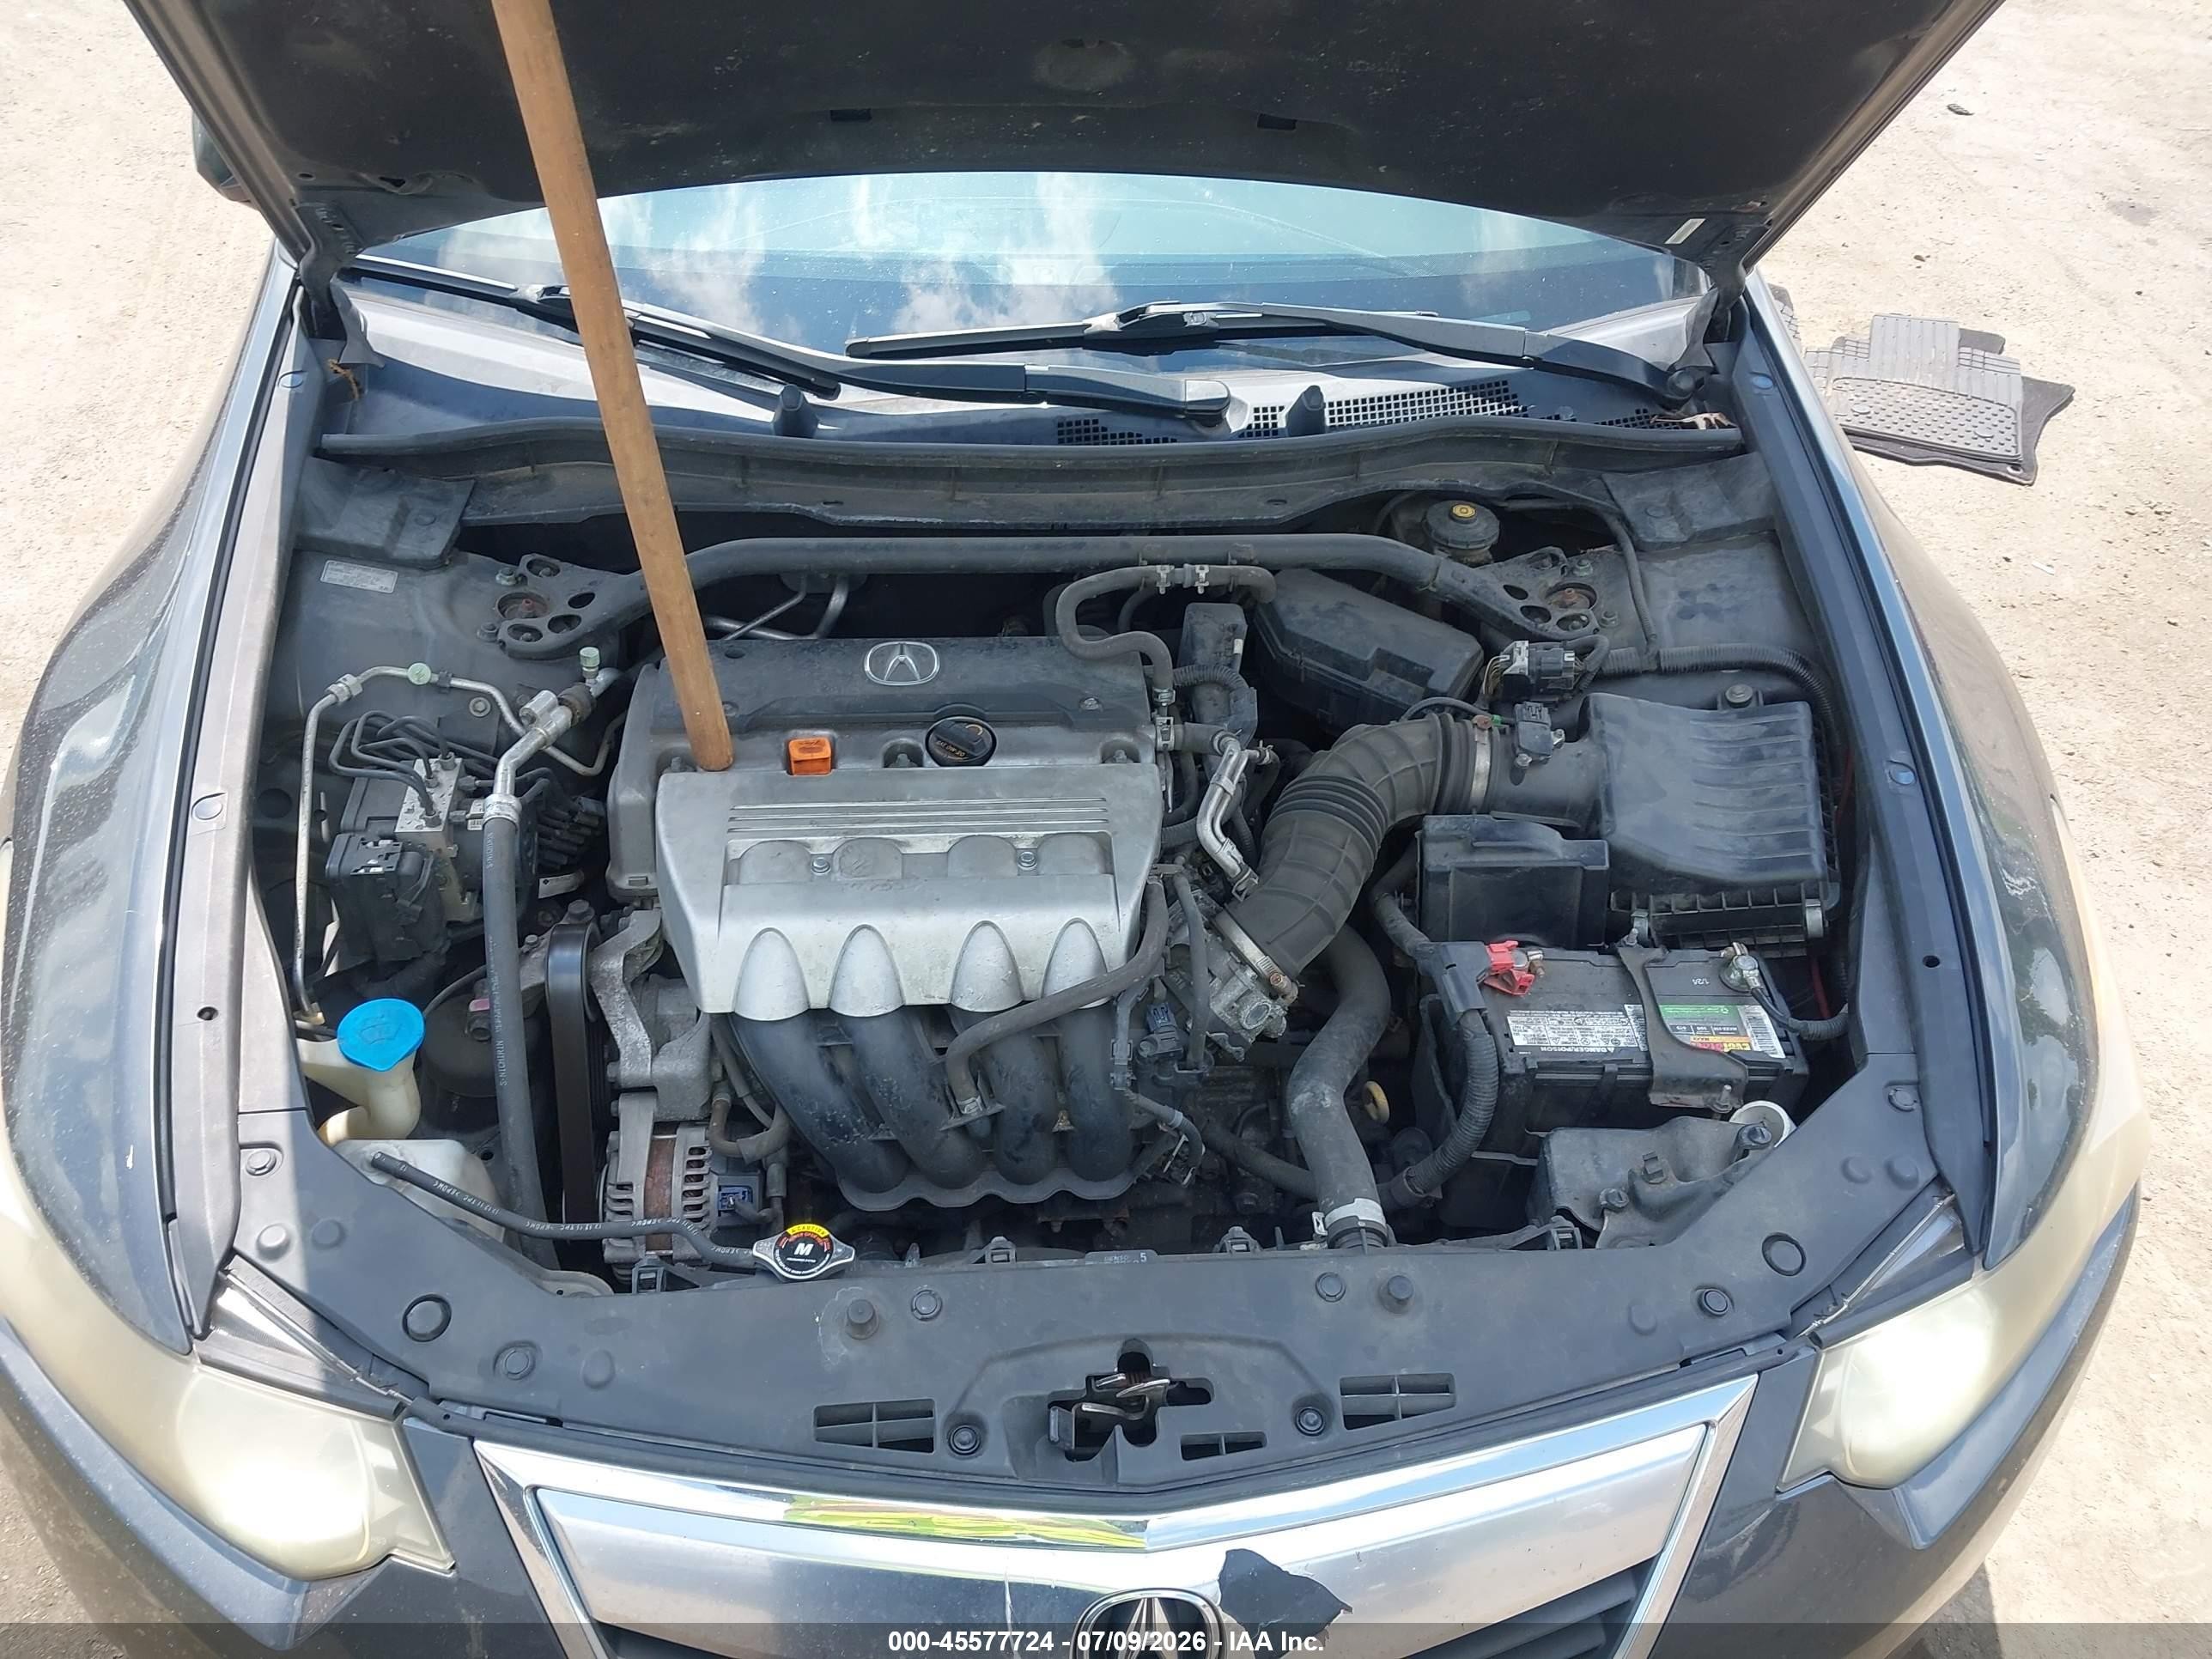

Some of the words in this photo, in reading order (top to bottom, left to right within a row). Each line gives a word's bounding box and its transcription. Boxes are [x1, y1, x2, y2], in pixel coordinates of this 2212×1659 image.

[797, 1225, 825, 1235] CAUTION
[793, 1243, 814, 1255] M
[1139, 1252, 1147, 1262] 5
